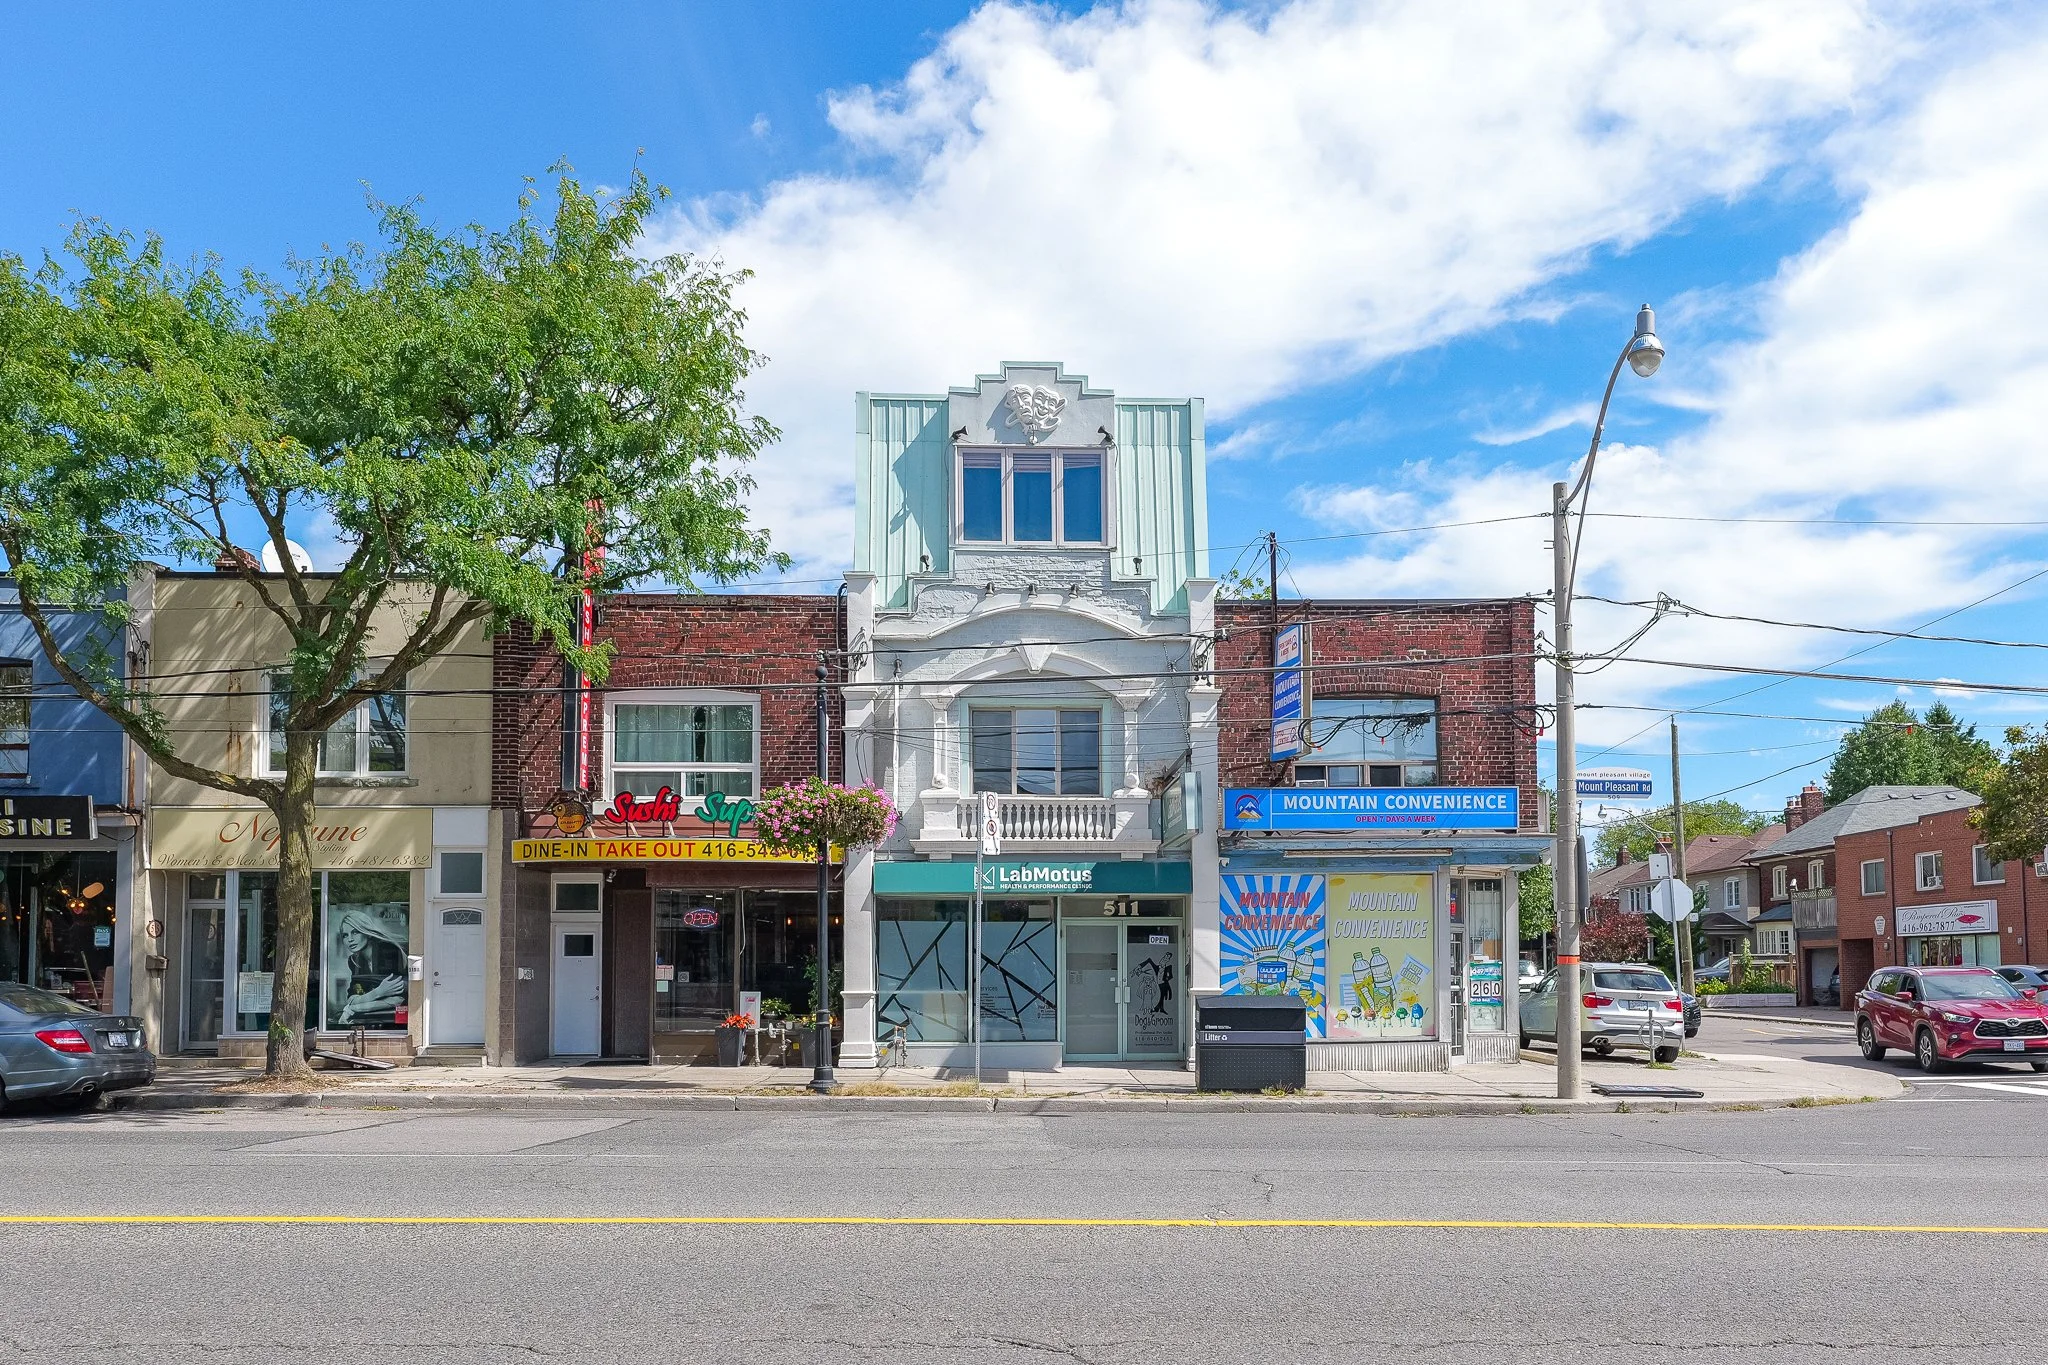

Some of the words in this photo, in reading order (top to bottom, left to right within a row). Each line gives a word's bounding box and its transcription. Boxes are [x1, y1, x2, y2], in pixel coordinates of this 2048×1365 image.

[1578, 781, 1603, 792] Mount
[1605, 781, 1639, 792] Pleasant
[1642, 783, 1651, 792] Rd
[604, 786, 683, 823] Sushi
[1283, 794, 1378, 810] MOUNTAIN
[1384, 794, 1507, 810] CONVENIENCE
[1355, 815, 1378, 823] OPEN
[1386, 815, 1405, 823] DAYS
[1413, 815, 1436, 823] WEEK
[523, 843, 587, 858] DINE-IN
[595, 842, 647, 857] TAKE
[653, 842, 695, 857] OUT
[158, 854, 207, 866] Women's
[212, 855, 222, 866] &
[226, 854, 265, 866] Men's
[328, 855, 430, 866] 416-481-6382
[1000, 866, 1093, 882] LabMotus
[1103, 900, 1140, 916] 511
[1239, 892, 1311, 908] MOUNTAIN
[1348, 892, 1419, 912] MOUNTAIN
[683, 912, 719, 925] OPEN
[1225, 914, 1321, 931] CONVENIENCE
[1902, 920, 1955, 933] 416-962-7877
[1334, 919, 1429, 939] CONVENIENCE
[1150, 936, 1168, 944] OPEN
[1204, 1032, 1221, 1041] Litter
